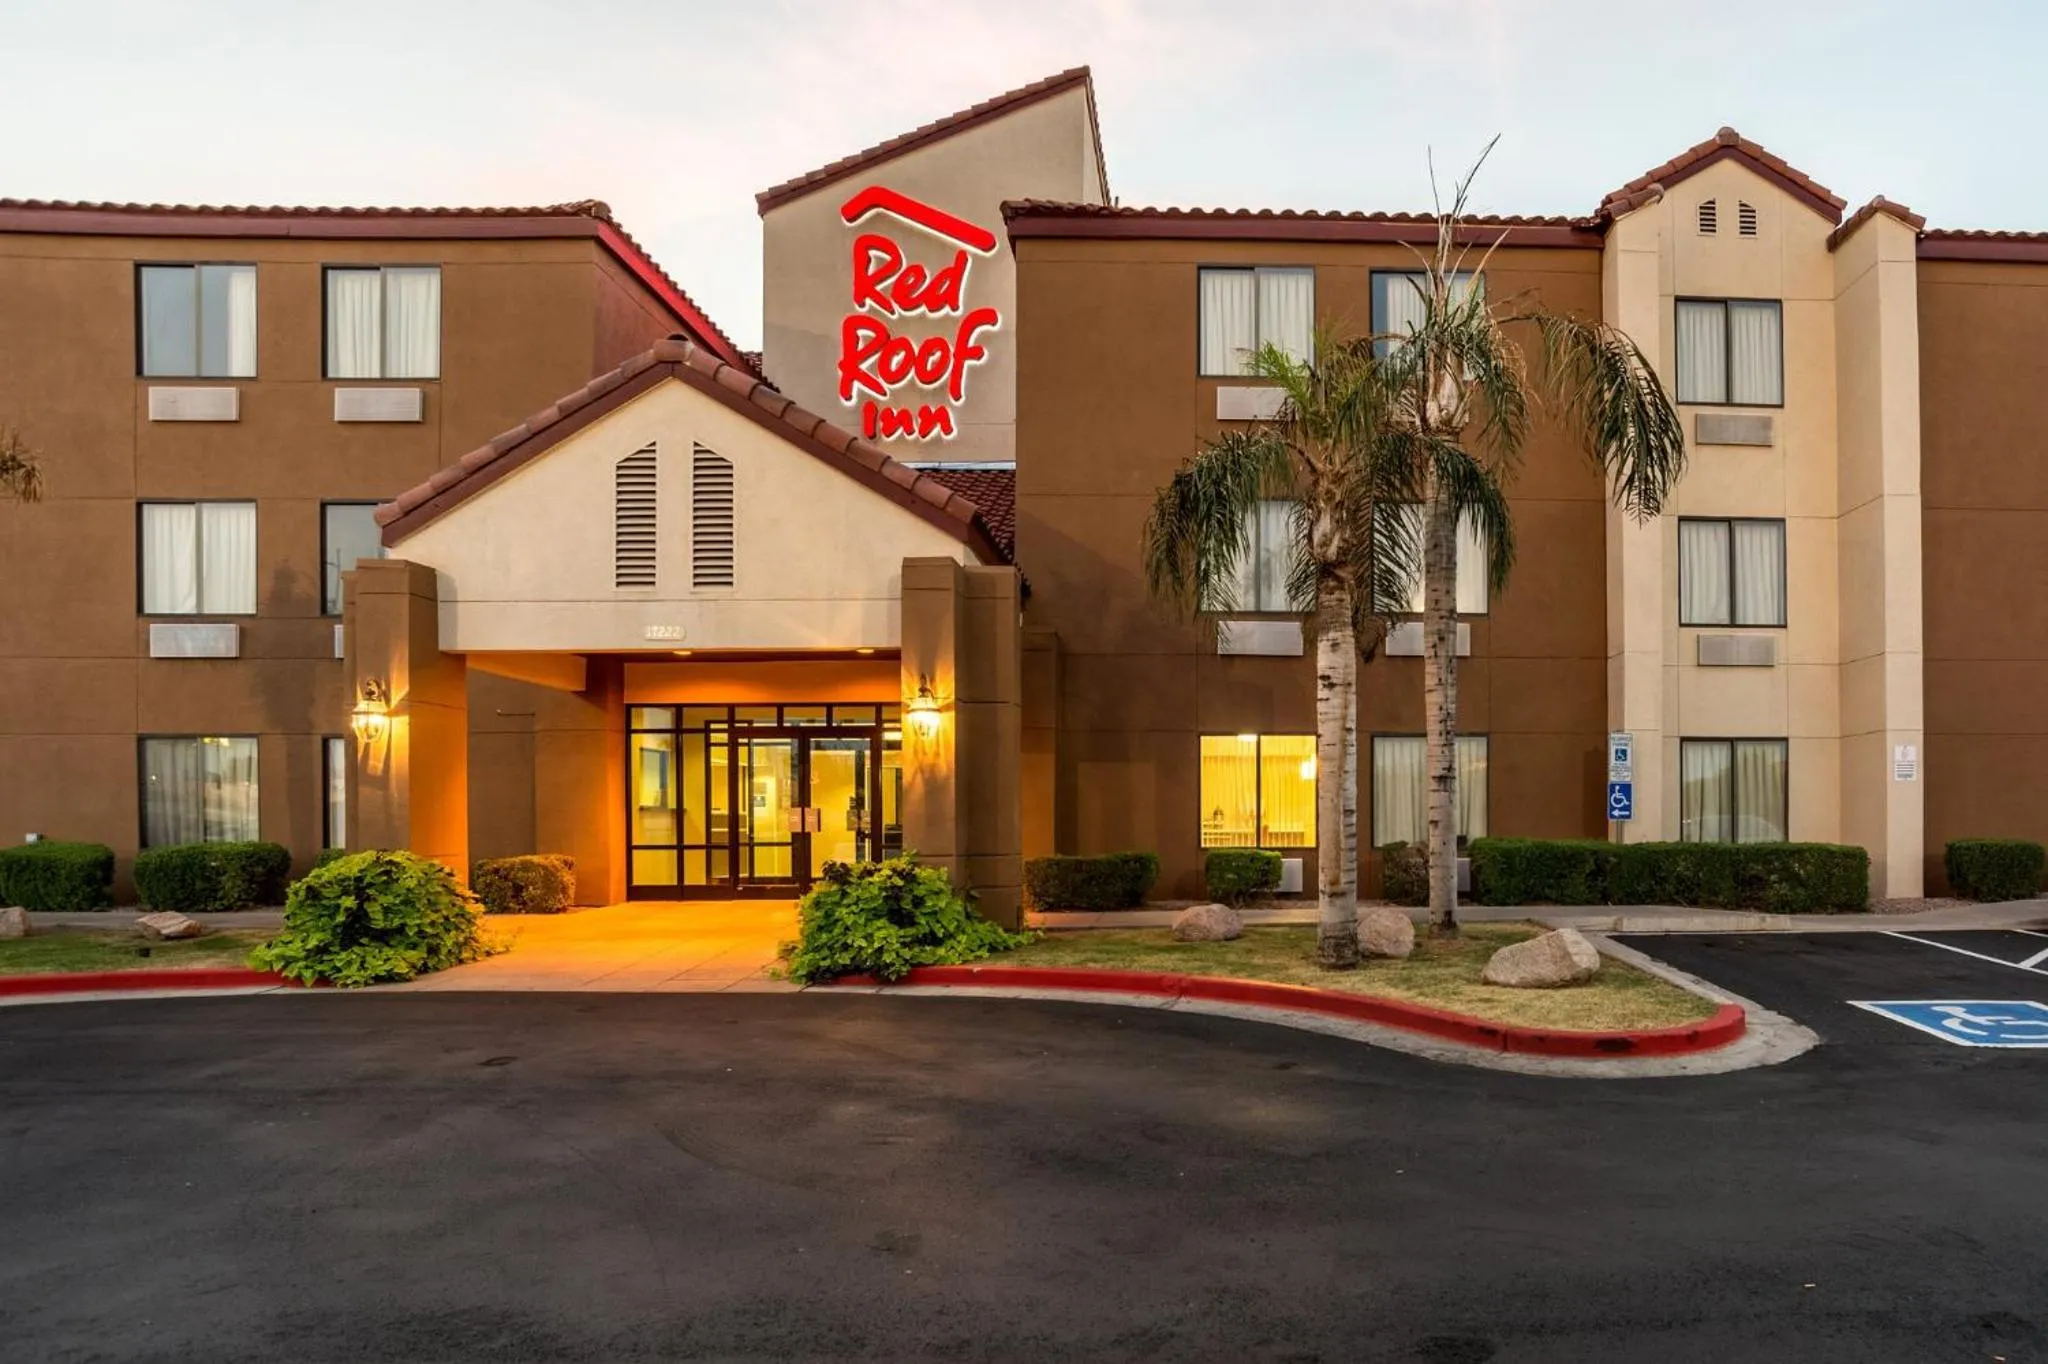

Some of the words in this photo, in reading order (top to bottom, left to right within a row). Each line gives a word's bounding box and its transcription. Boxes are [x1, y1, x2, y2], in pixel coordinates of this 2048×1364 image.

[853, 234, 969, 314] Red
[838, 308, 999, 402] Roof
[862, 400, 954, 439] Inn
